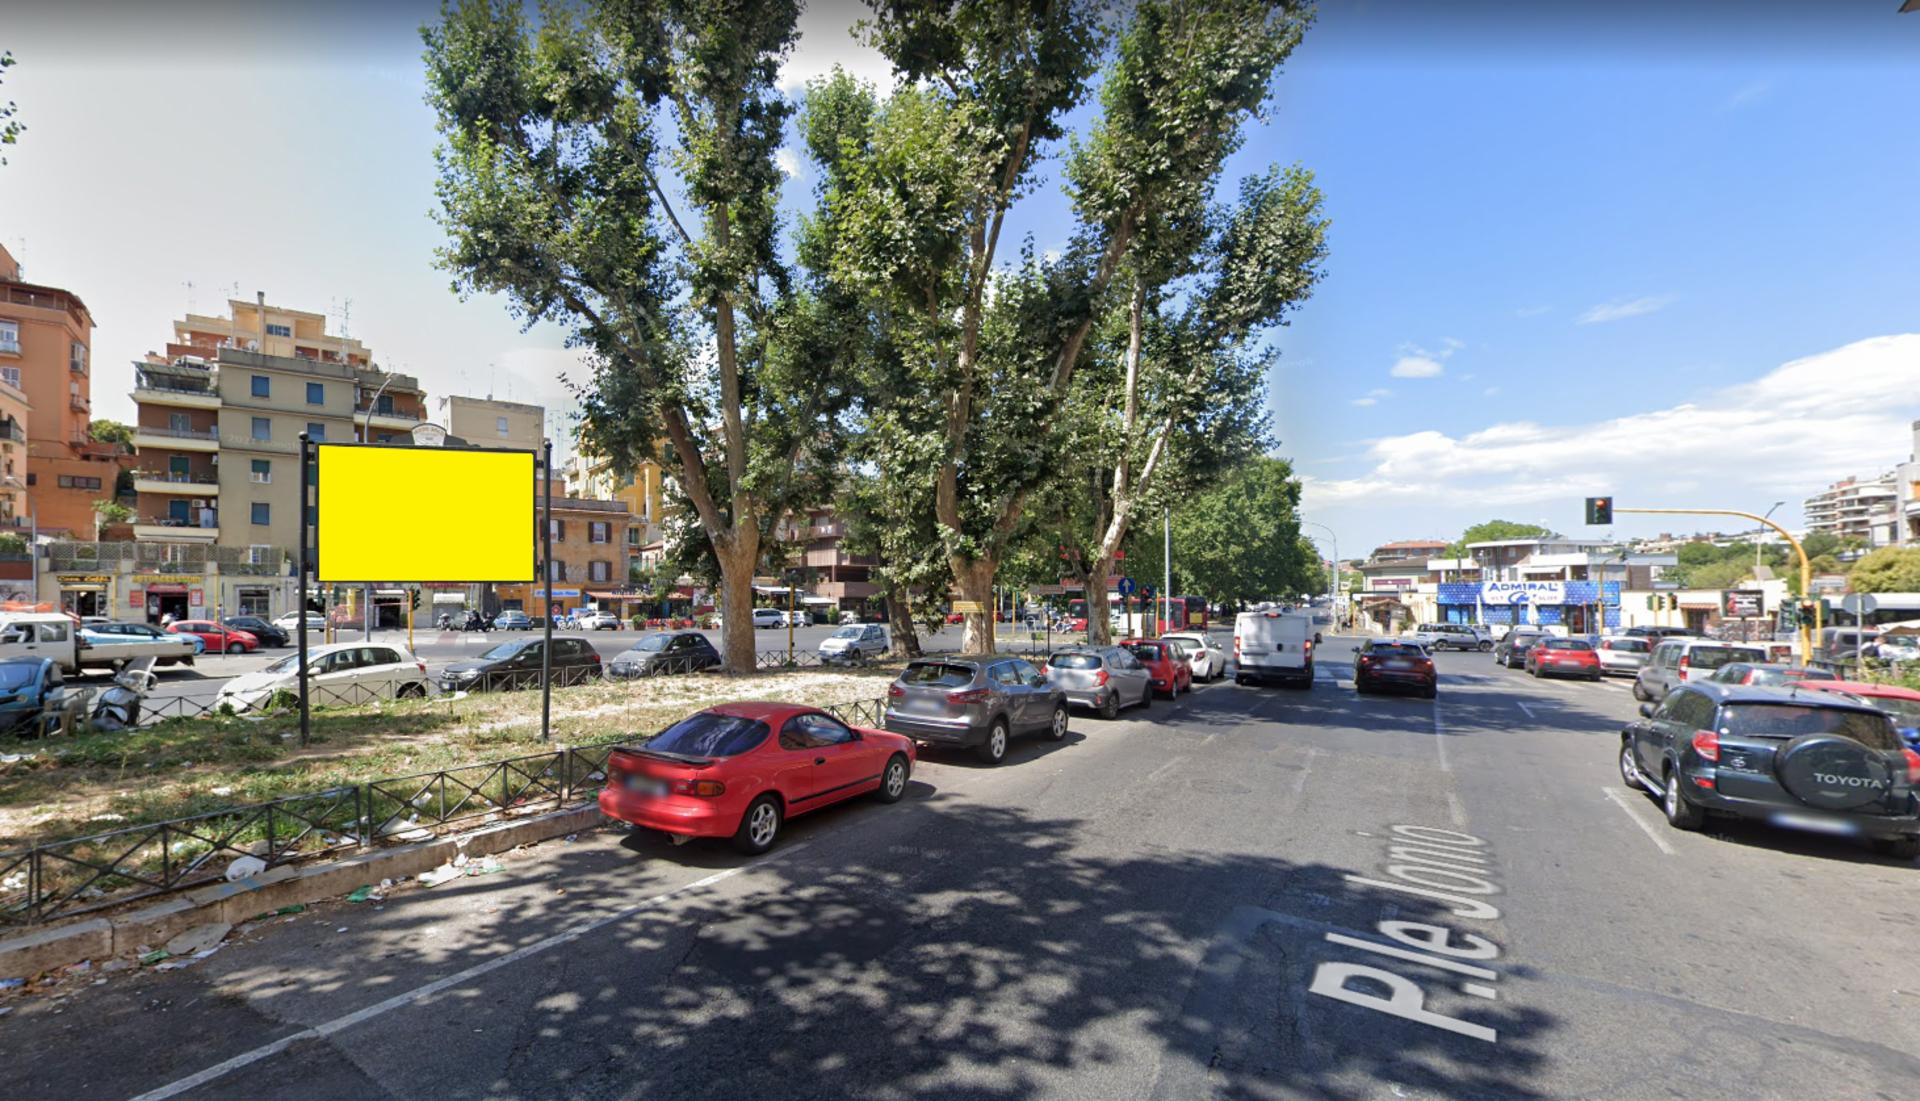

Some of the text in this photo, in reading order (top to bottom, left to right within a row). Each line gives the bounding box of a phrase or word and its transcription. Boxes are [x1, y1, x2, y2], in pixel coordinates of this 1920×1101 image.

[1488, 583, 1557, 592] ADMIRAL
[1814, 773, 1883, 789] TOYOTA
[1308, 824, 1501, 1043] P.le Jonio
